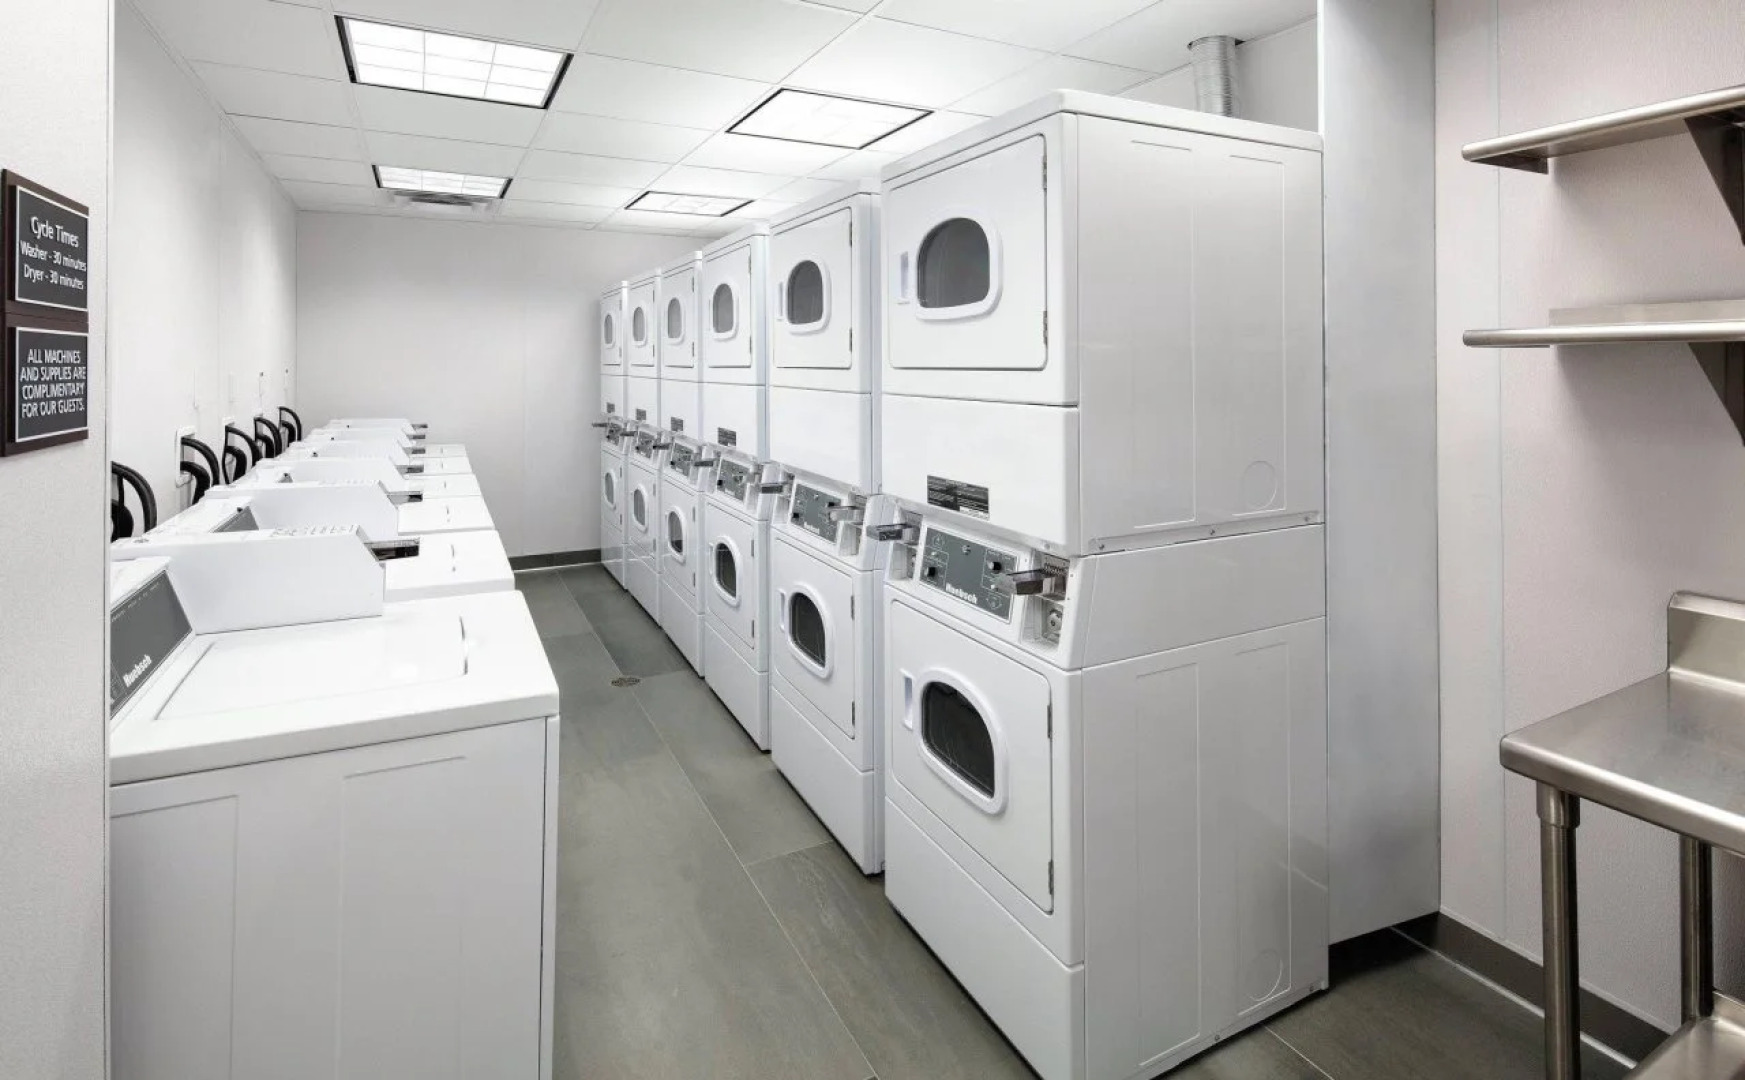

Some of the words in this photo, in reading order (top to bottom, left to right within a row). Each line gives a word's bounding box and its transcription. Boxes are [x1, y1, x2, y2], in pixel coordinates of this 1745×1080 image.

[31, 216, 54, 240] Cycle
[55, 224, 79, 248] Times
[20, 239, 48, 261] Washer
[52, 250, 62, 265] 30
[63, 254, 87, 272] minutes
[23, 263, 44, 283] Dryer
[49, 269, 58, 284] 30
[59, 273, 84, 290] minutes
[27, 348, 43, 364] ALL
[44, 349, 81, 364] MACHINES
[20, 366, 39, 382] AND
[40, 366, 72, 381] SUPPLIES
[73, 366, 87, 380] ARE
[22, 382, 85, 400] COMPLIMENTARY
[21, 402, 39, 418] FOR
[40, 400, 57, 416] OUR
[58, 397, 85, 414] GUESTS.
